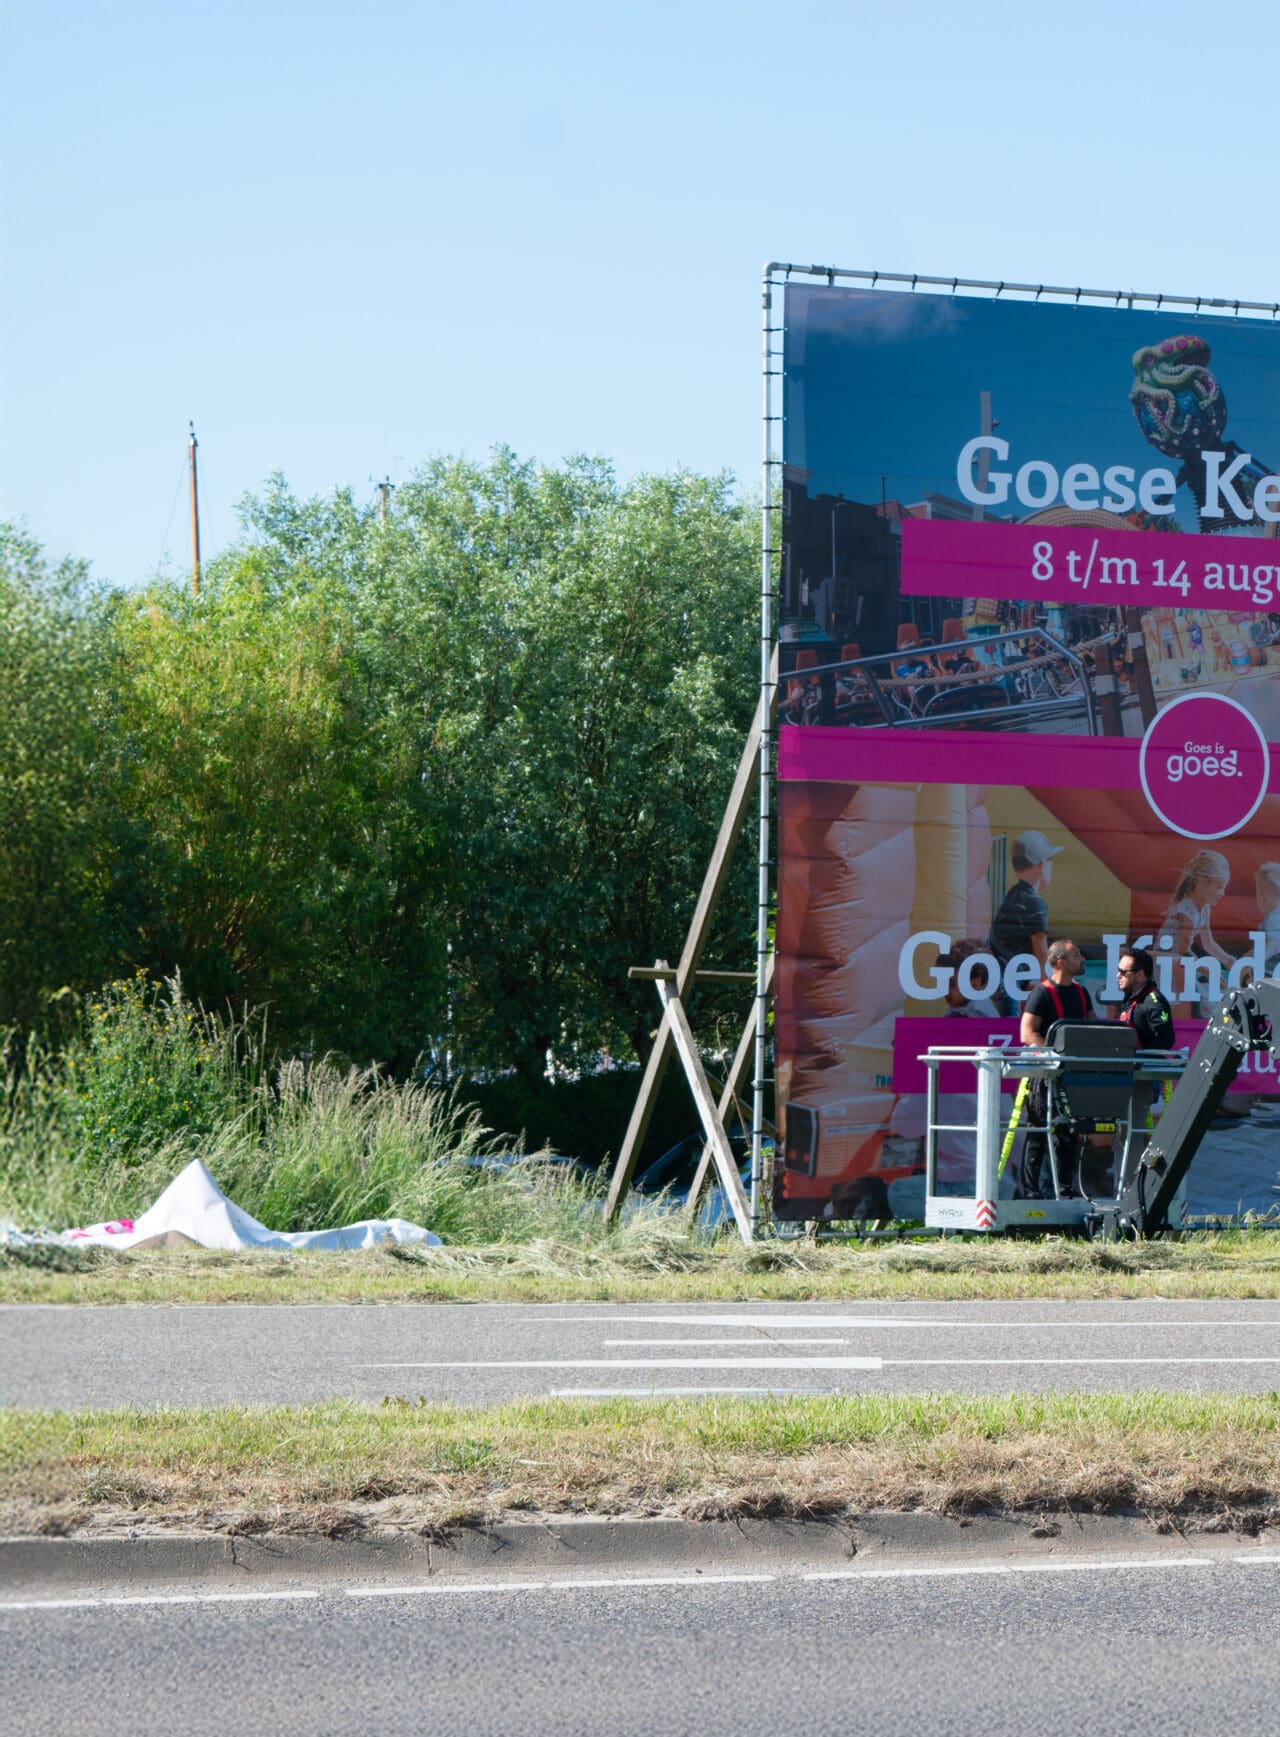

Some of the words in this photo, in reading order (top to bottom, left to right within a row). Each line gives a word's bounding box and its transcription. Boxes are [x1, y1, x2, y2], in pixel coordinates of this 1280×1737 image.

[957, 435, 1178, 515] Goese
[1031, 541, 1054, 581] 8
[1066, 539, 1139, 589] t/m
[1152, 559, 1191, 596] 14
[1184, 741, 1212, 753] Goes
[1215, 742, 1225, 754] is
[898, 931, 1053, 1000] Goe
